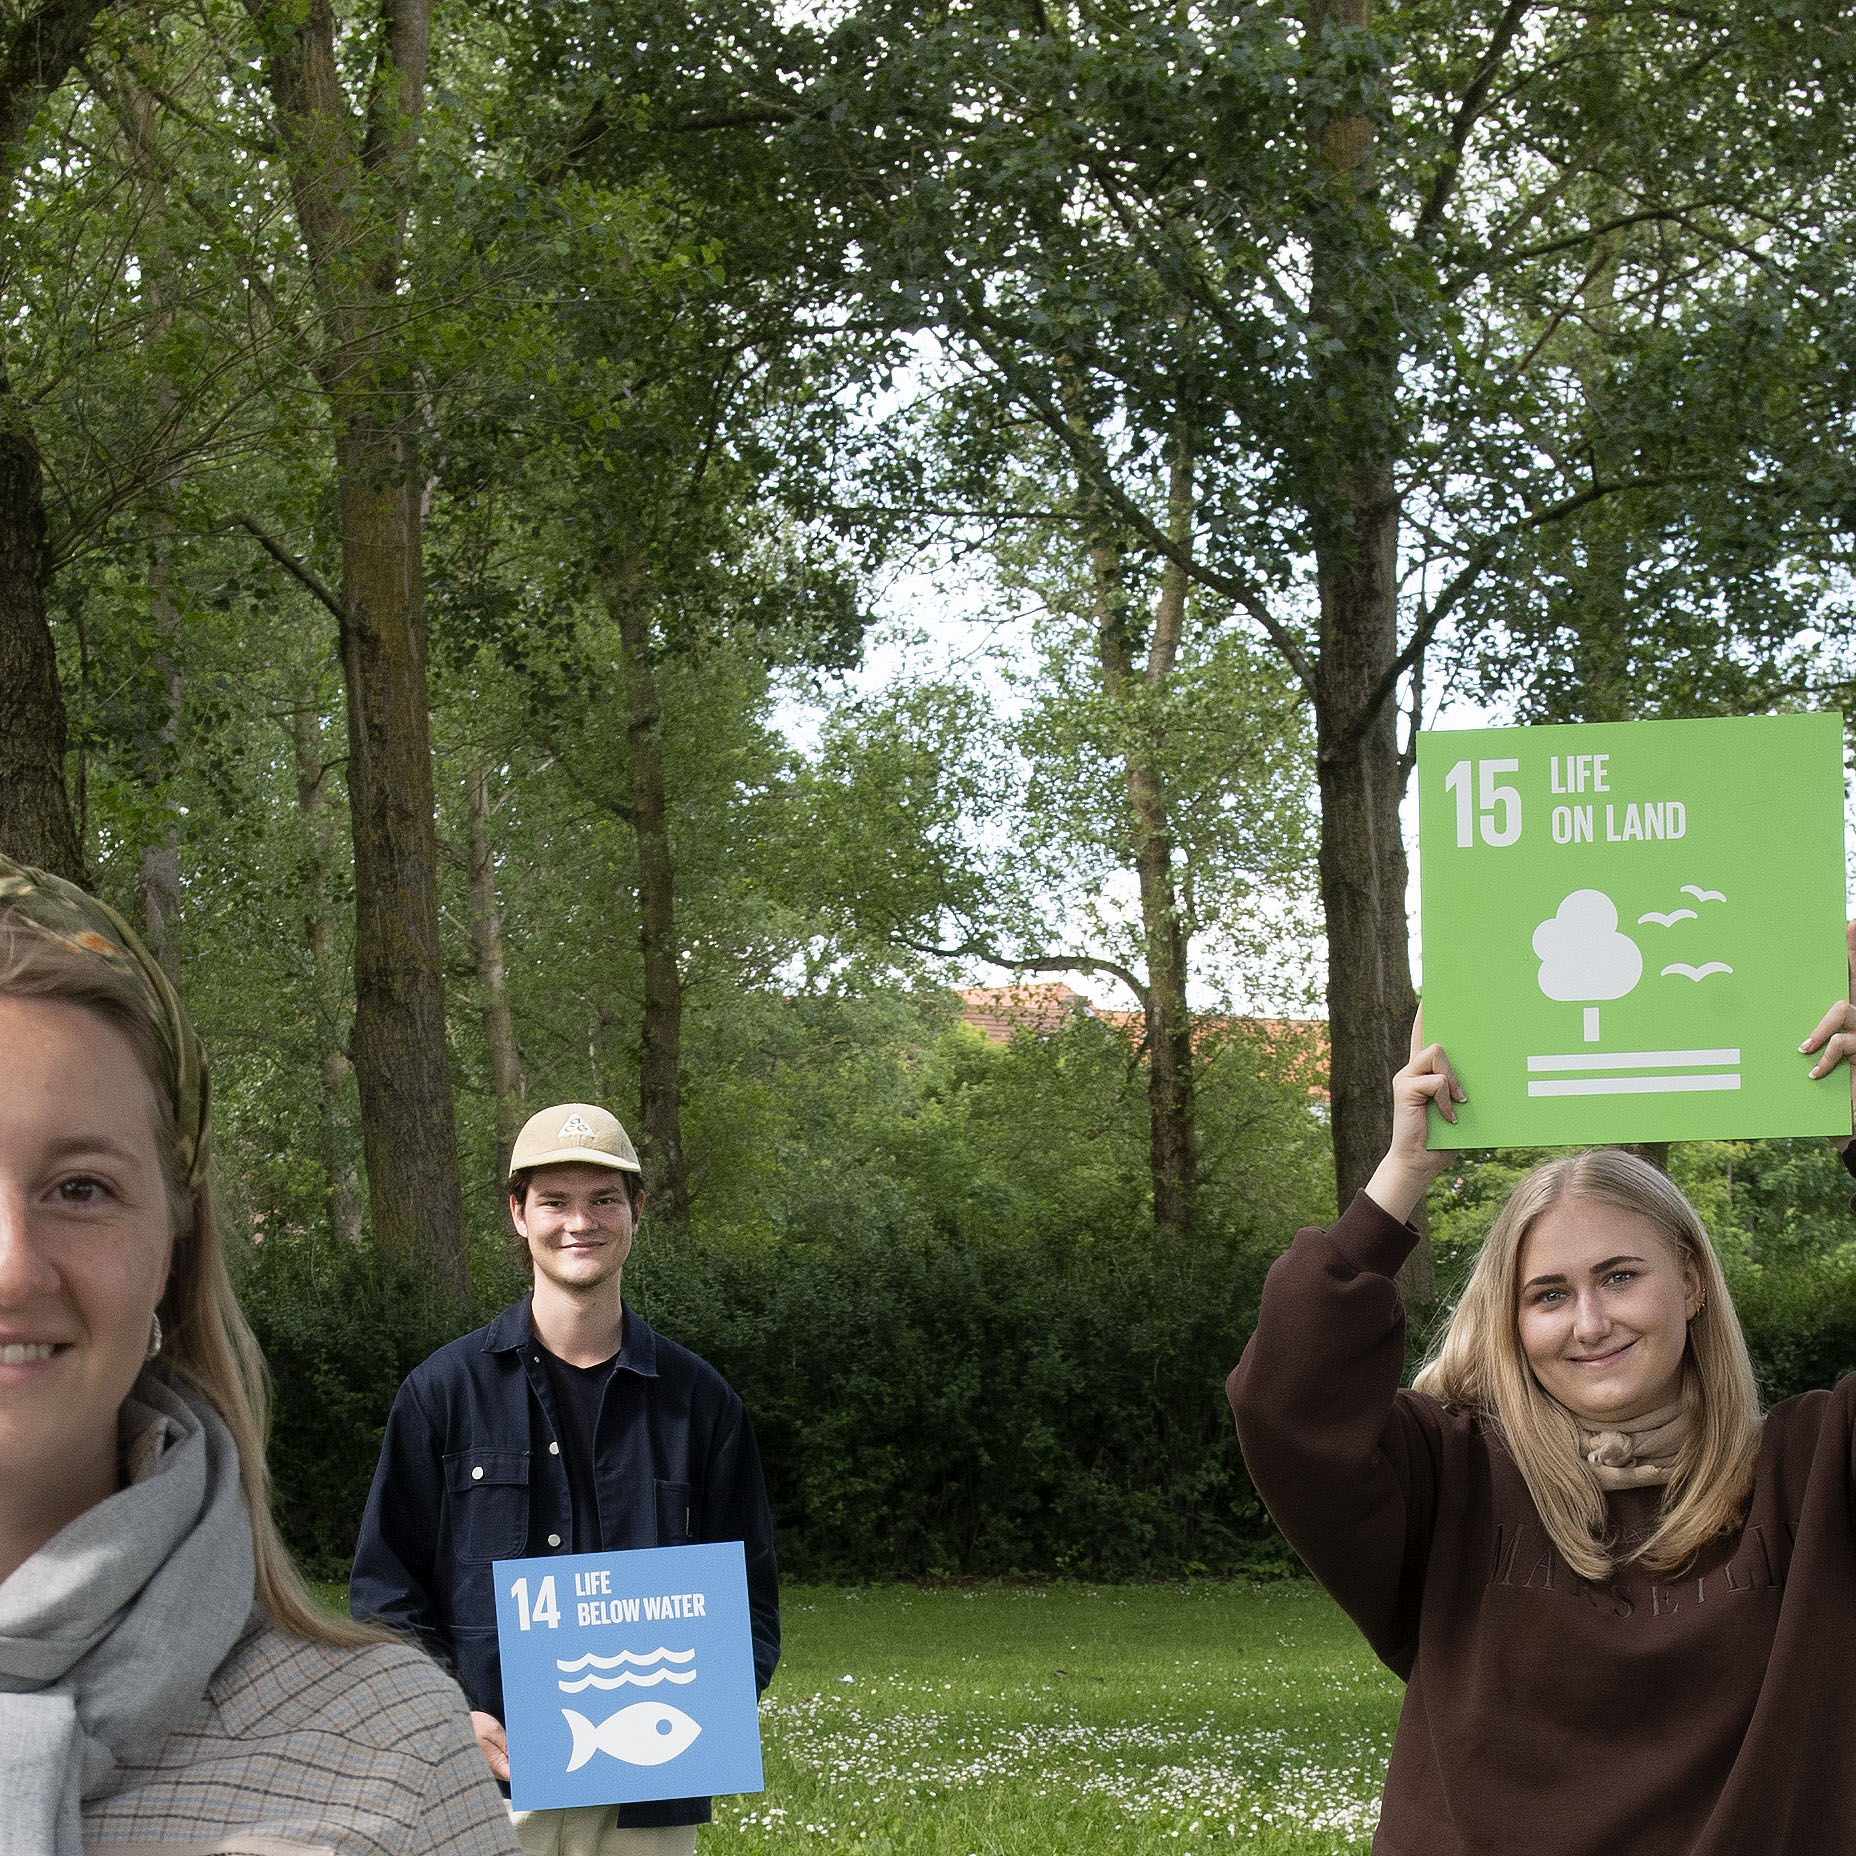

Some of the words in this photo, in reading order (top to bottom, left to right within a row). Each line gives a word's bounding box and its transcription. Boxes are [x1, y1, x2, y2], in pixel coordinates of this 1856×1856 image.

[1551, 754, 1611, 795] LIFE
[1446, 759, 1523, 848] 15
[1552, 805, 1594, 845] ON
[1606, 802, 1686, 842] LAND
[511, 1576, 561, 1632] 14
[575, 1571, 612, 1597] LIFE
[578, 1598, 640, 1627] BELOW
[644, 1594, 706, 1621] WATER
